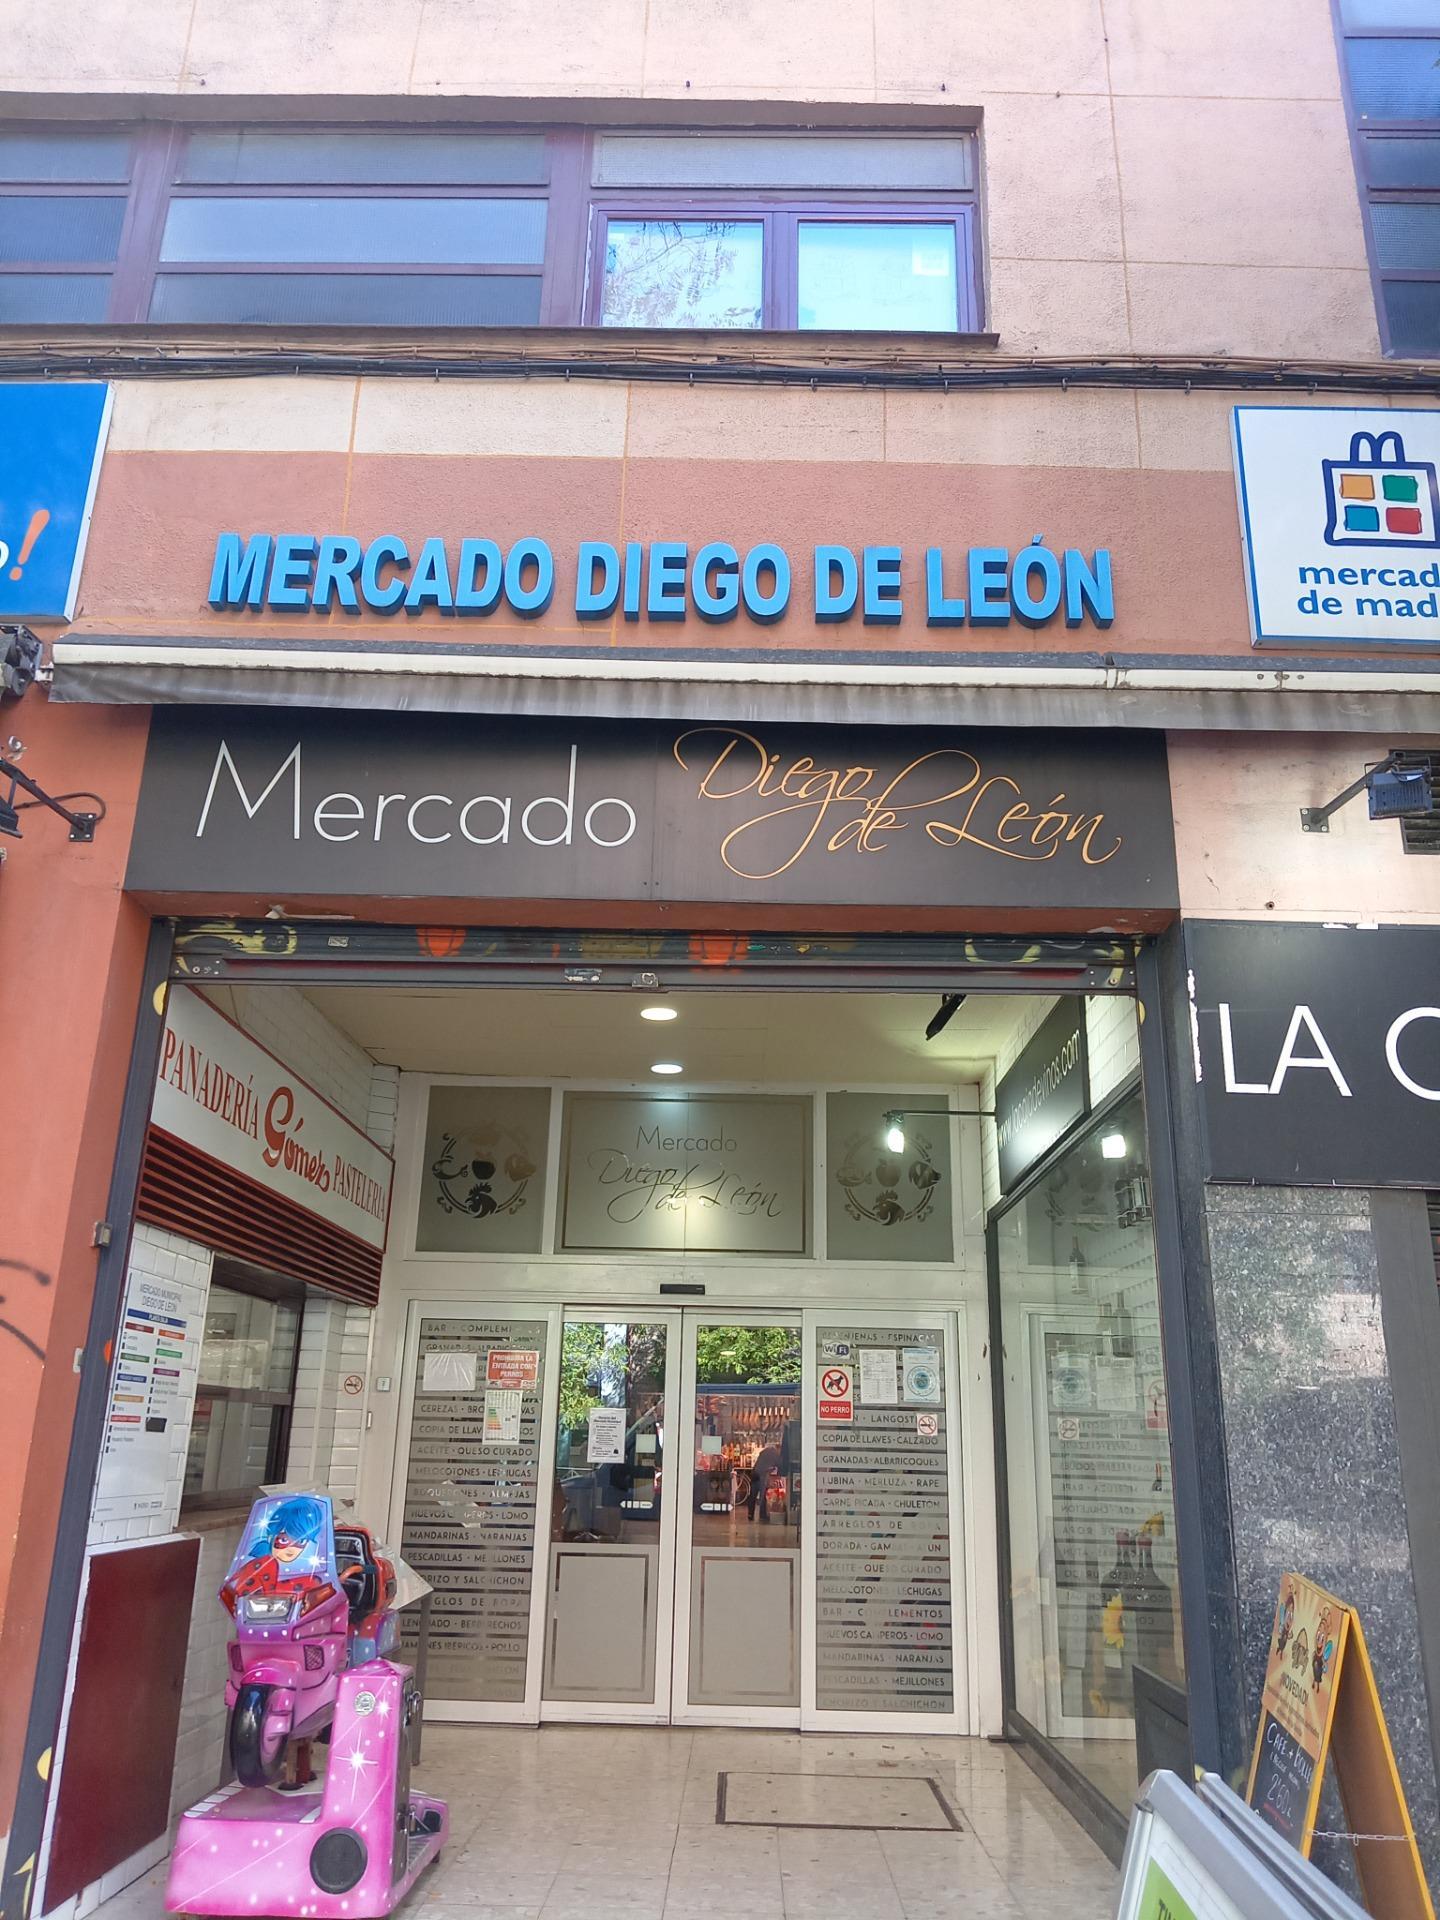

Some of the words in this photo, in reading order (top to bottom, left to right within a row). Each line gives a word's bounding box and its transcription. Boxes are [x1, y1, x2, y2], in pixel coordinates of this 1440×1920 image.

[208, 532, 556, 619] MERCADO
[576, 541, 792, 626] DIEGO
[815, 544, 903, 627] DE
[926, 533, 1115, 630] LEÓN
[1297, 590, 1343, 615] de
[1356, 593, 1439, 618] mad
[196, 738, 637, 848] Mercado
[673, 727, 878, 879] Diego
[925, 776, 1122, 865] León
[1218, 1002, 1353, 1097] LA
[159, 1027, 260, 1140] PANADERÍA
[262, 1086, 331, 1193] Gómez
[636, 1125, 738, 1153] Mercado
[586, 1147, 678, 1223] Diego
[820, 1406, 830, 1414] NO
[419, 1425, 445, 1433] COPIA
[448, 1425, 459, 1434] DE
[822, 1433, 848, 1442] COPIA
[850, 1434, 860, 1443] DE
[862, 1434, 891, 1444] LLAVES
[896, 1436, 938, 1446] CALZADO
[457, 1446, 490, 1456] QUESO
[493, 1447, 533, 1457] CURADO
[822, 1455, 869, 1464] GRANADAS
[873, 1456, 939, 1466] ALBARICOQUES
[822, 1476, 855, 1485] LUBINA
[917, 1479, 940, 1488] RAPE
[823, 1498, 851, 1506] CARNE
[894, 1499, 940, 1509] CHULETON
[501, 1511, 528, 1521] LOMO
[822, 1520, 881, 1529] ARREGLOS
[889, 1521, 903, 1530] DE
[409, 1531, 469, 1541] MANDARINAS
[480, 1533, 527, 1543] NARANJAS
[822, 1541, 862, 1550] DORADA
[408, 1552, 463, 1562] PESCADILLAS
[474, 1554, 526, 1564] MELLONES
[455, 1575, 460, 1584] Y
[464, 1576, 525, 1587] SALCICHON
[471, 1597, 484, 1607] DE
[823, 1607, 842, 1616] BAR
[402, 1617, 451, 1627] LENADO
[859, 1630, 908, 1641] CAPEROS
[916, 1631, 944, 1642] LOMO
[401, 1641, 442, 1651] JAMNES
[490, 1643, 521, 1653] POLLO
[895, 1653, 944, 1664] NARANJAS
[892, 1677, 945, 1687] MEJILLONES
